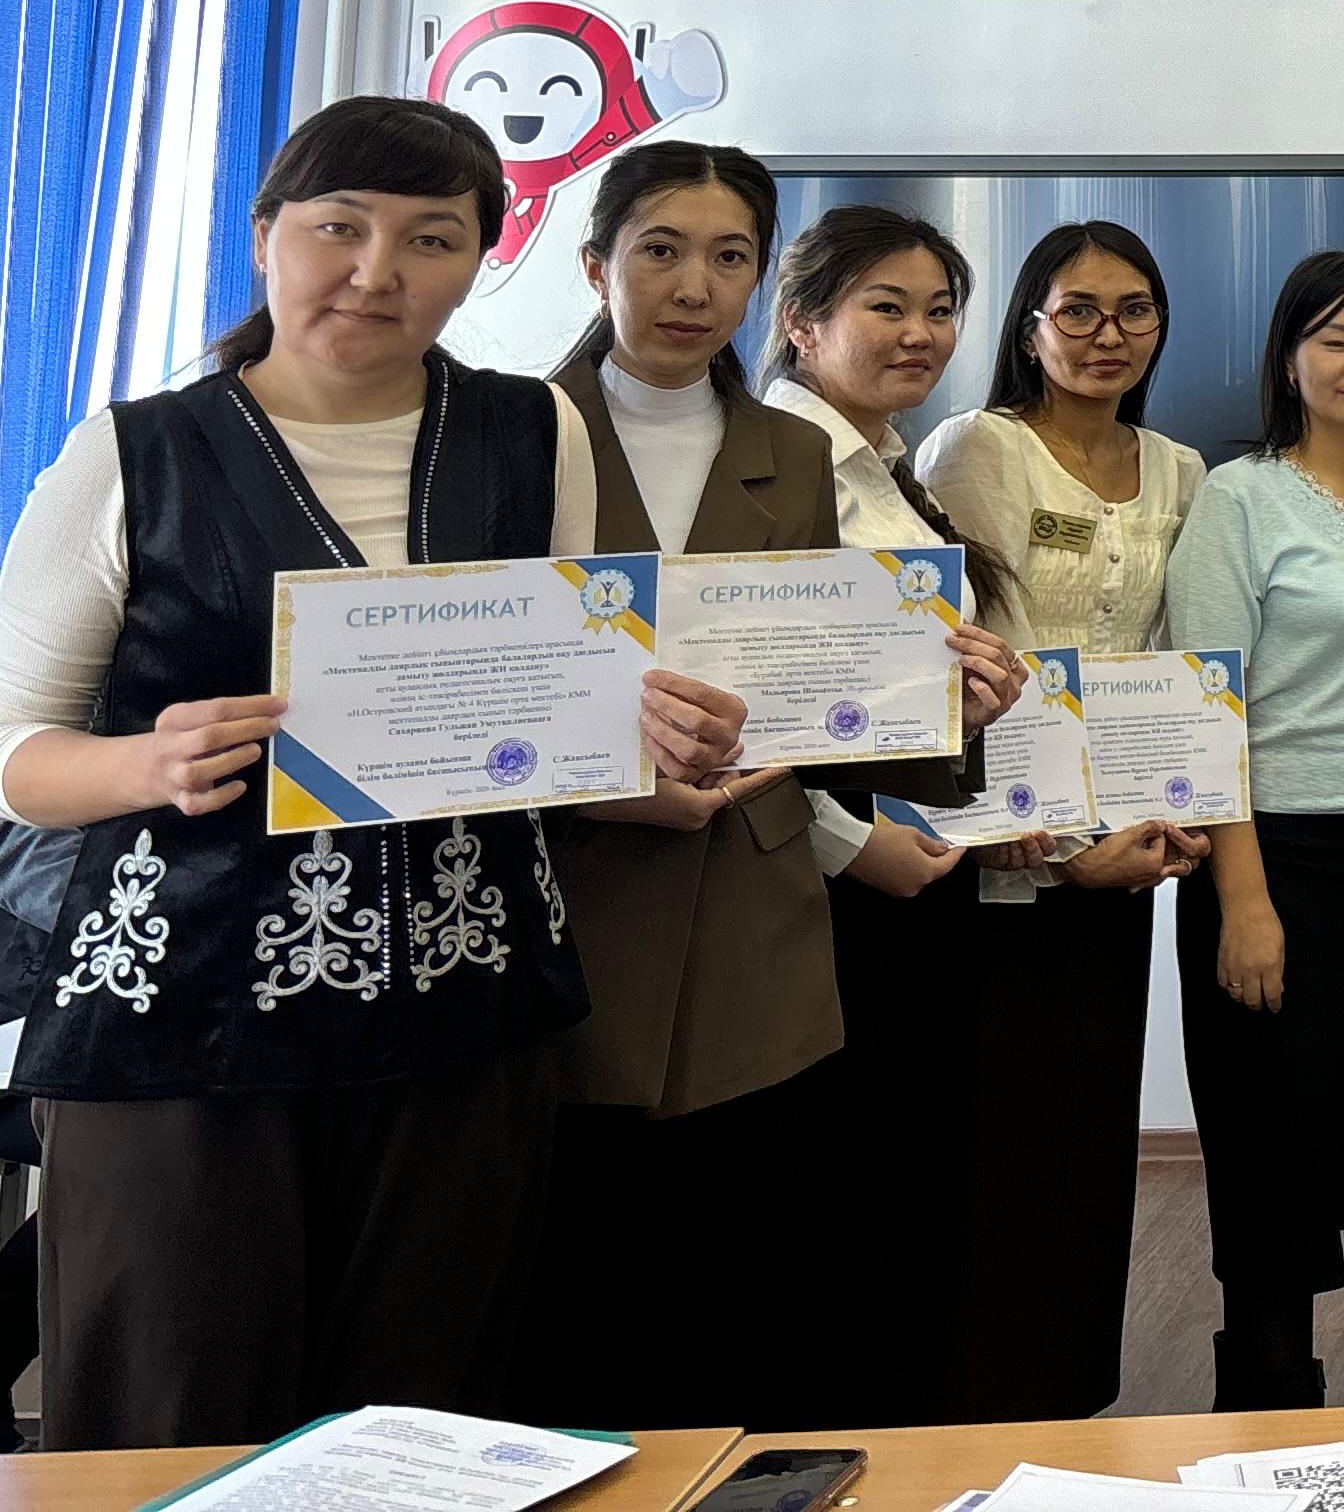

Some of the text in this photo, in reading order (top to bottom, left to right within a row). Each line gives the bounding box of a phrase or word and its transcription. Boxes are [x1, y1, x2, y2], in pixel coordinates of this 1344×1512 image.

[699, 581, 857, 604] СЕРТИФИКАТ
[346, 596, 535, 628] СЕРТИФИКАТ
[1082, 677, 1174, 697] ЕРТИФИКАТ
